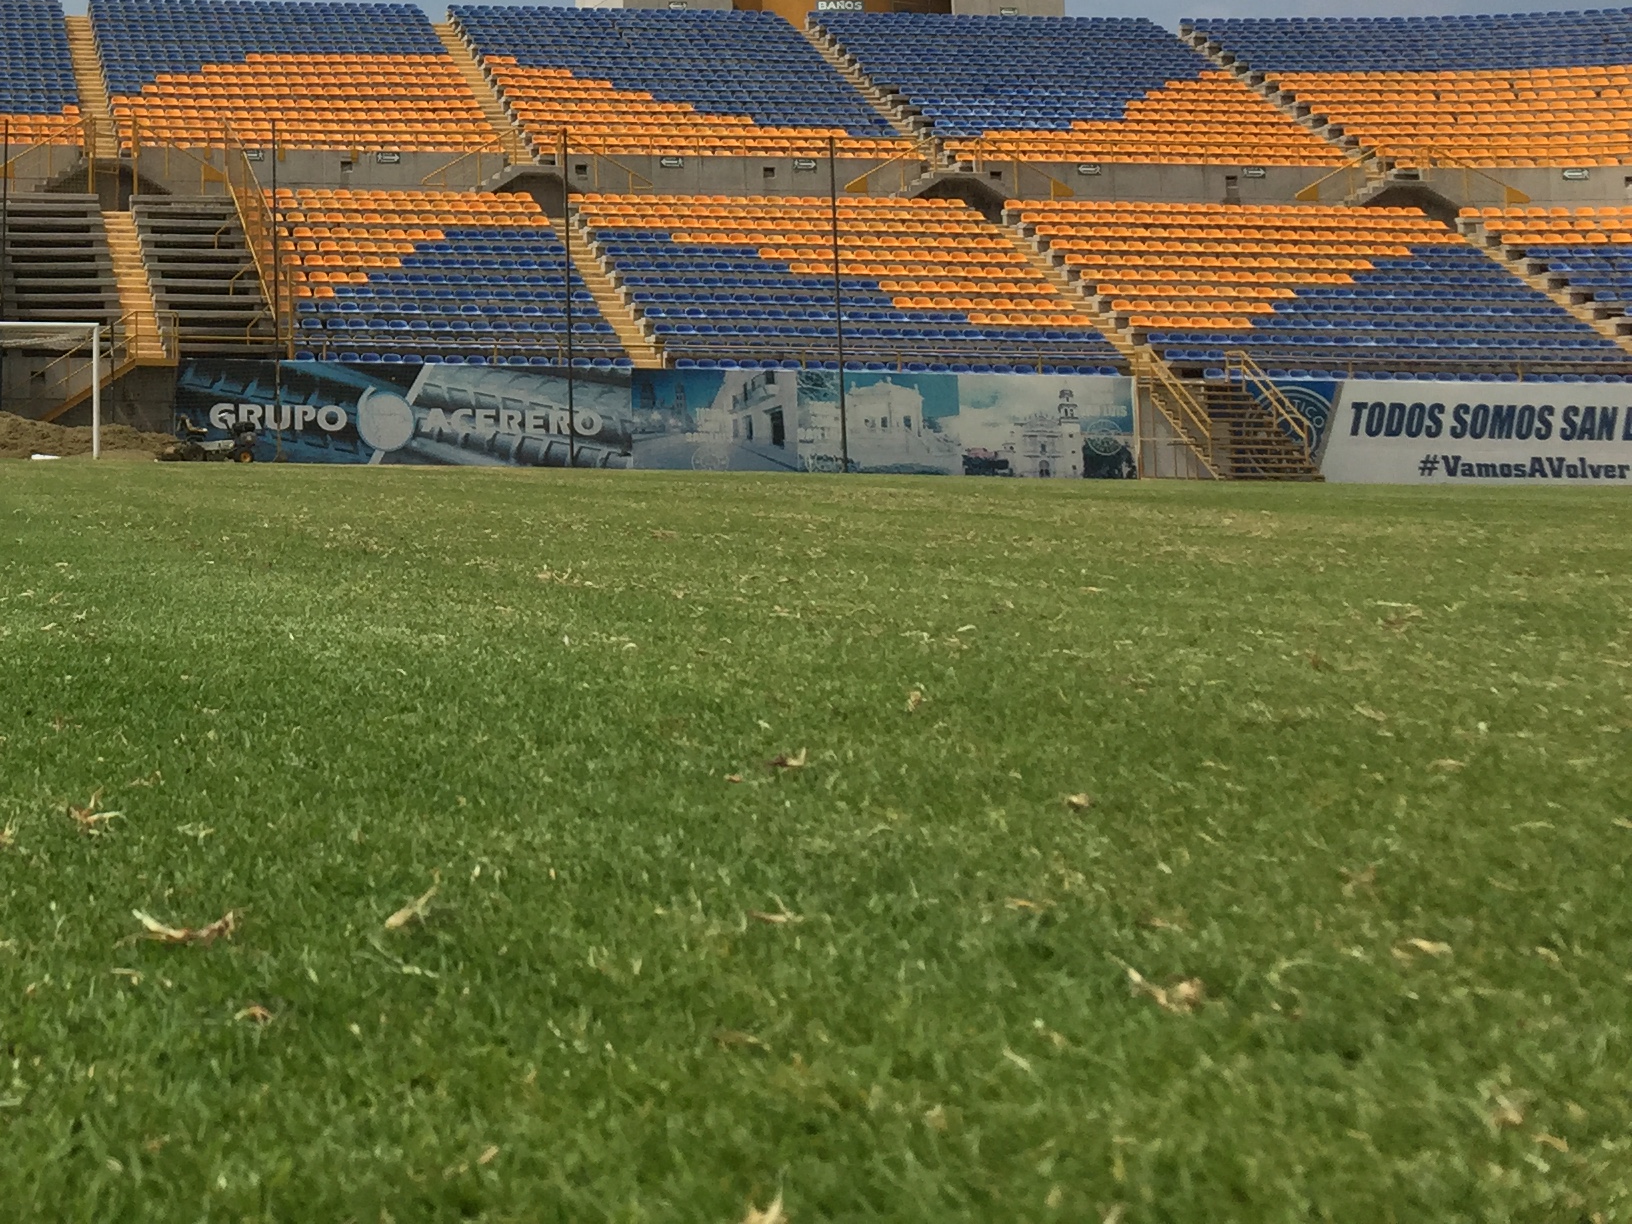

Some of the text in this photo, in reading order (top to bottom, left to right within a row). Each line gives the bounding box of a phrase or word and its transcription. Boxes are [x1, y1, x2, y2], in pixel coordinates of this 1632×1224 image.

[818, 0, 863, 11] BAÑOS
[209, 402, 604, 436] GRUPO ACERERO
[1350, 401, 1446, 438] TODOS
[1449, 403, 1555, 440] SOMOS
[1559, 405, 1619, 441] SAN
[1418, 454, 1631, 480] #VamosAVolver
